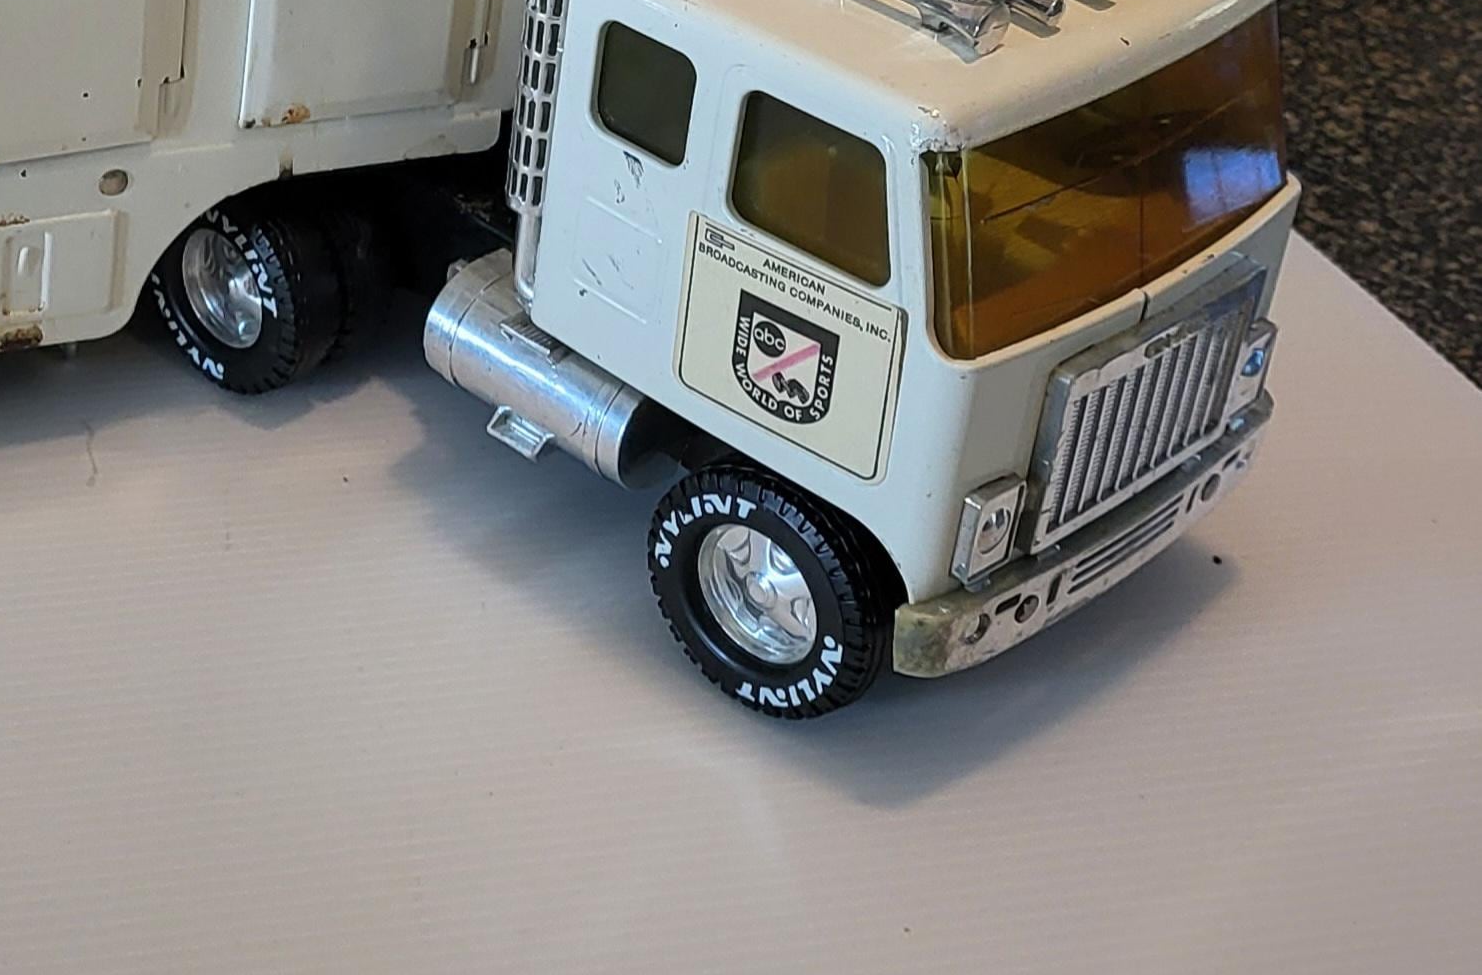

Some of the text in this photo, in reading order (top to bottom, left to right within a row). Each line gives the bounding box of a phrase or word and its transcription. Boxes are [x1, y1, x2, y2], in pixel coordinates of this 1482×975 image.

[698, 241, 786, 293] BROADCASTING
[865, 321, 891, 343] INC.
[762, 258, 826, 296] AMERICAN
[735, 315, 835, 422] WIDE WORLD OF SPORTS
[753, 325, 786, 352] abc
[655, 492, 758, 569] NYLINT
[734, 634, 845, 709] NYLINT
